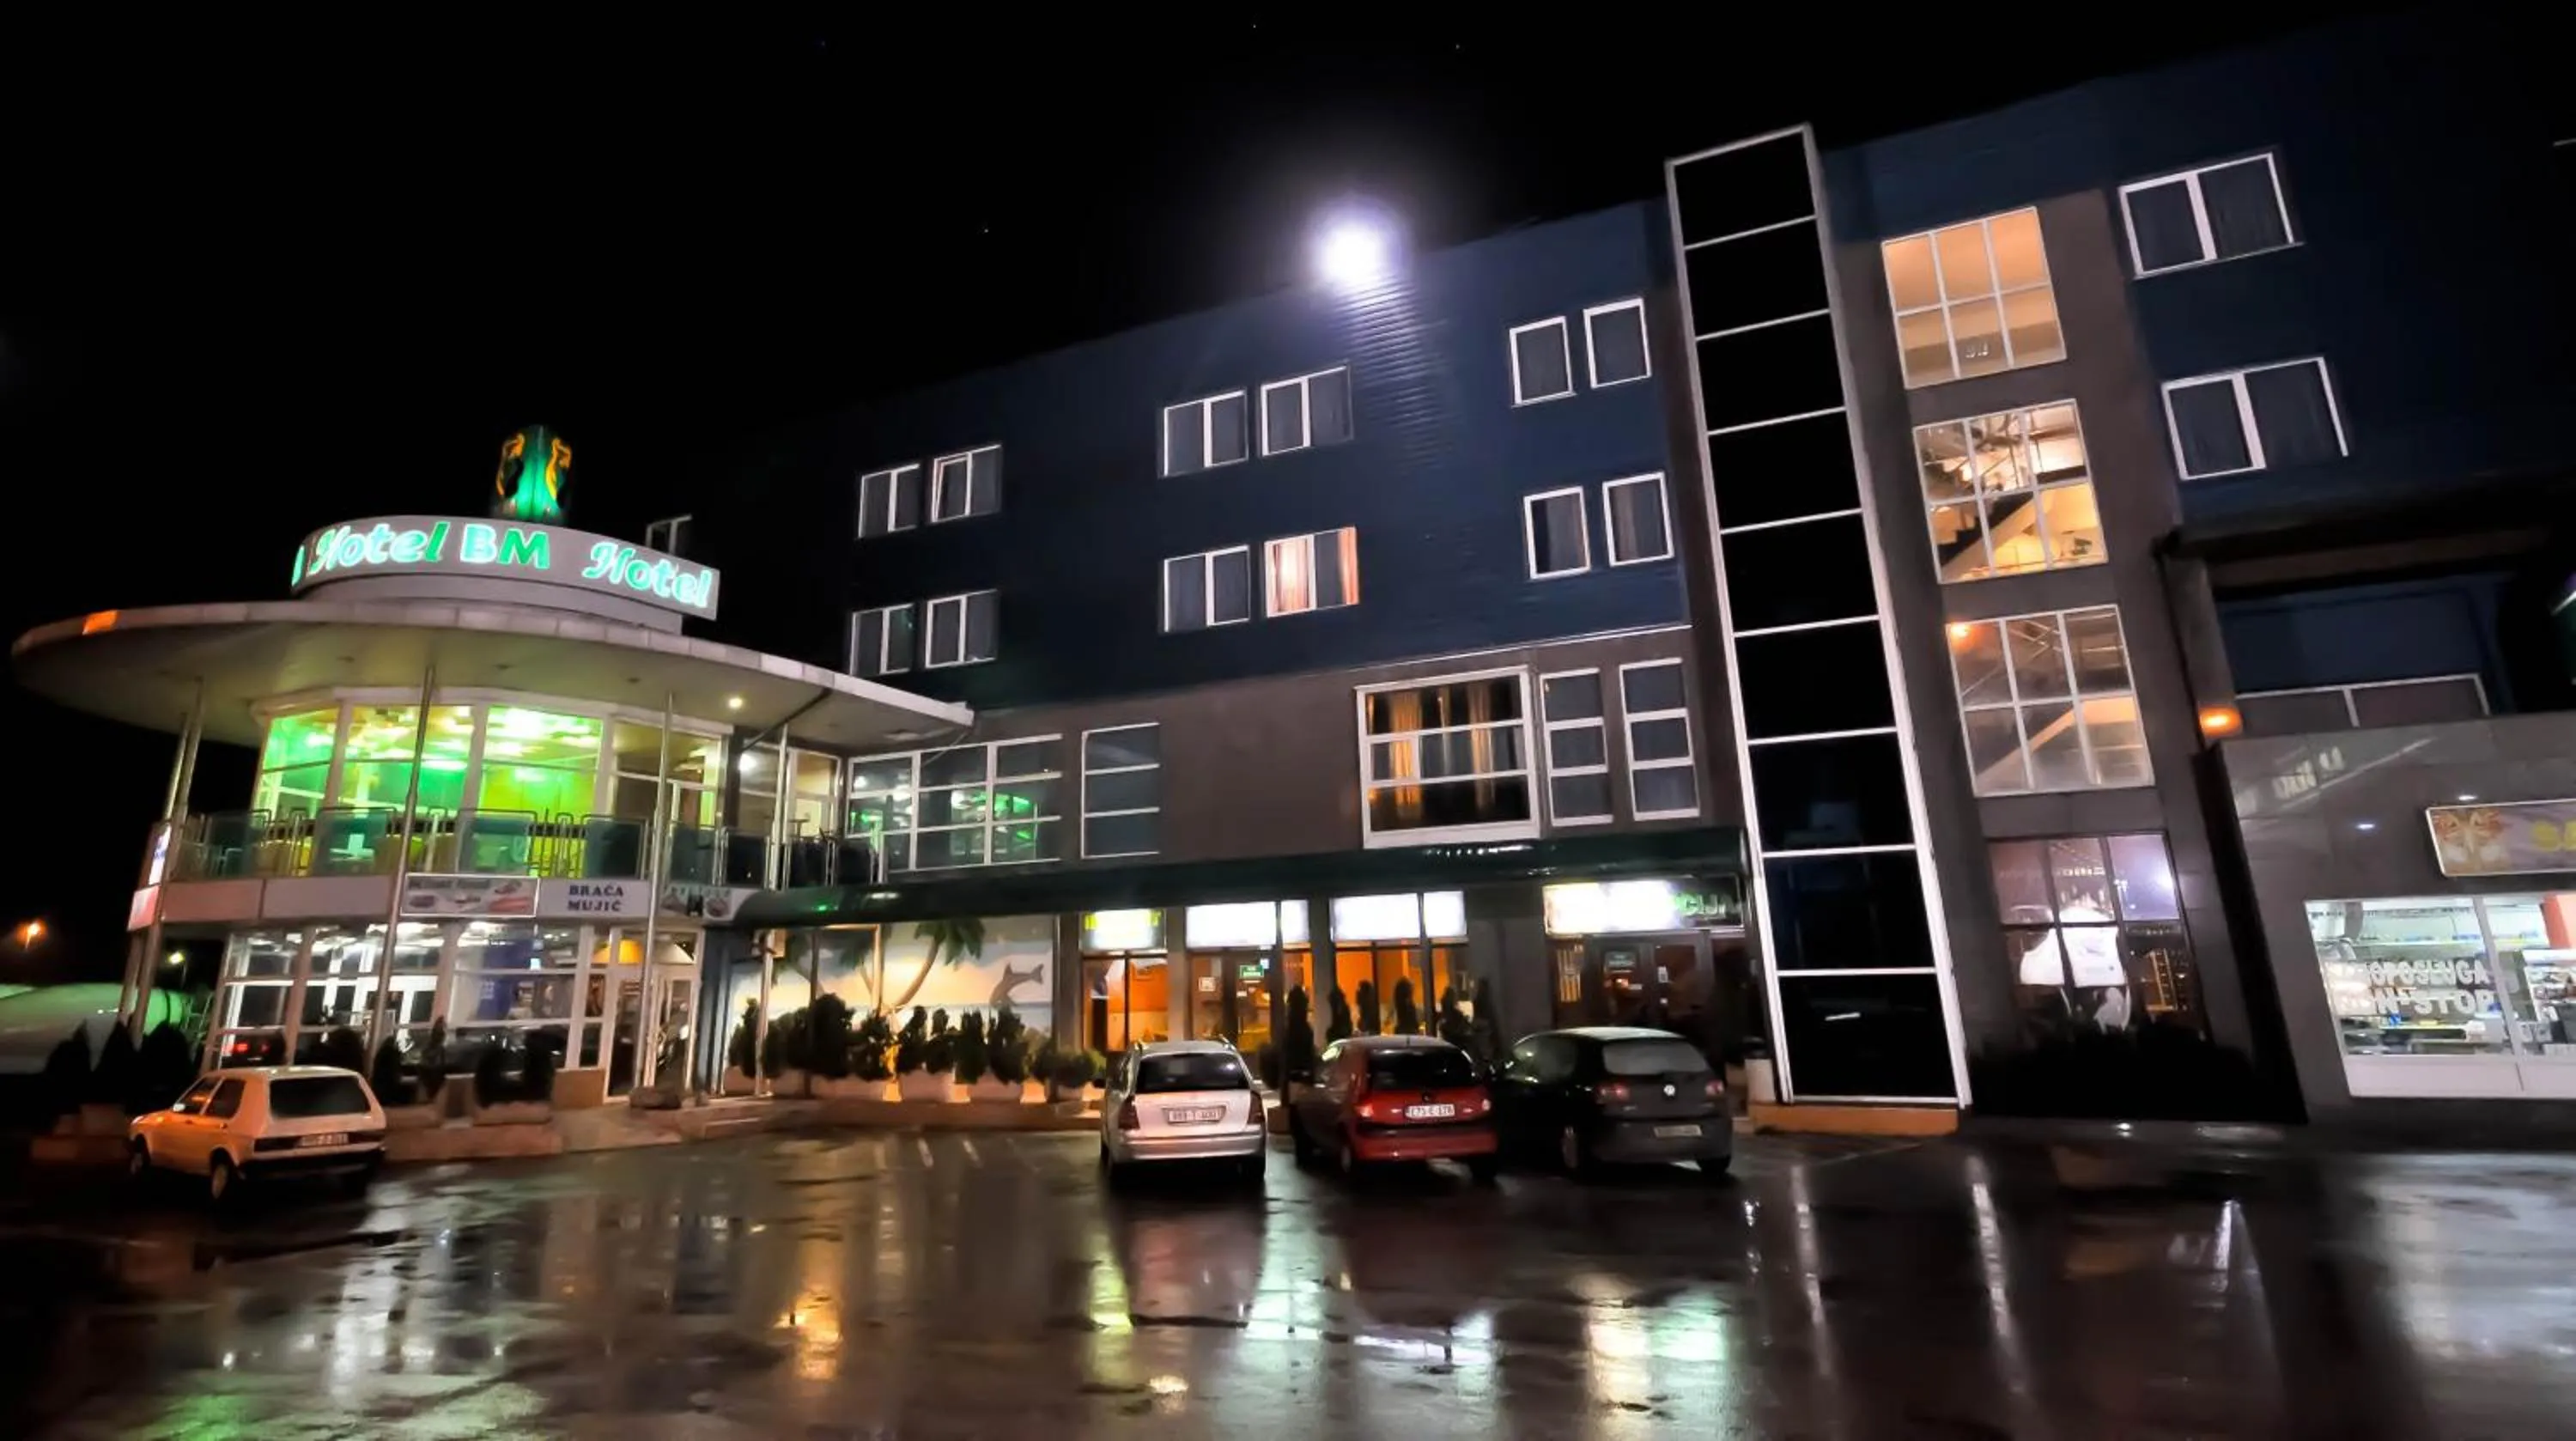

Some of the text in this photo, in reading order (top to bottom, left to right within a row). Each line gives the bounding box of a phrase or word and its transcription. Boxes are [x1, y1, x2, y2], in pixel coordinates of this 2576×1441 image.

[307, 521, 450, 576] Hotel
[459, 523, 550, 569] BM
[582, 541, 714, 608] Hotel
